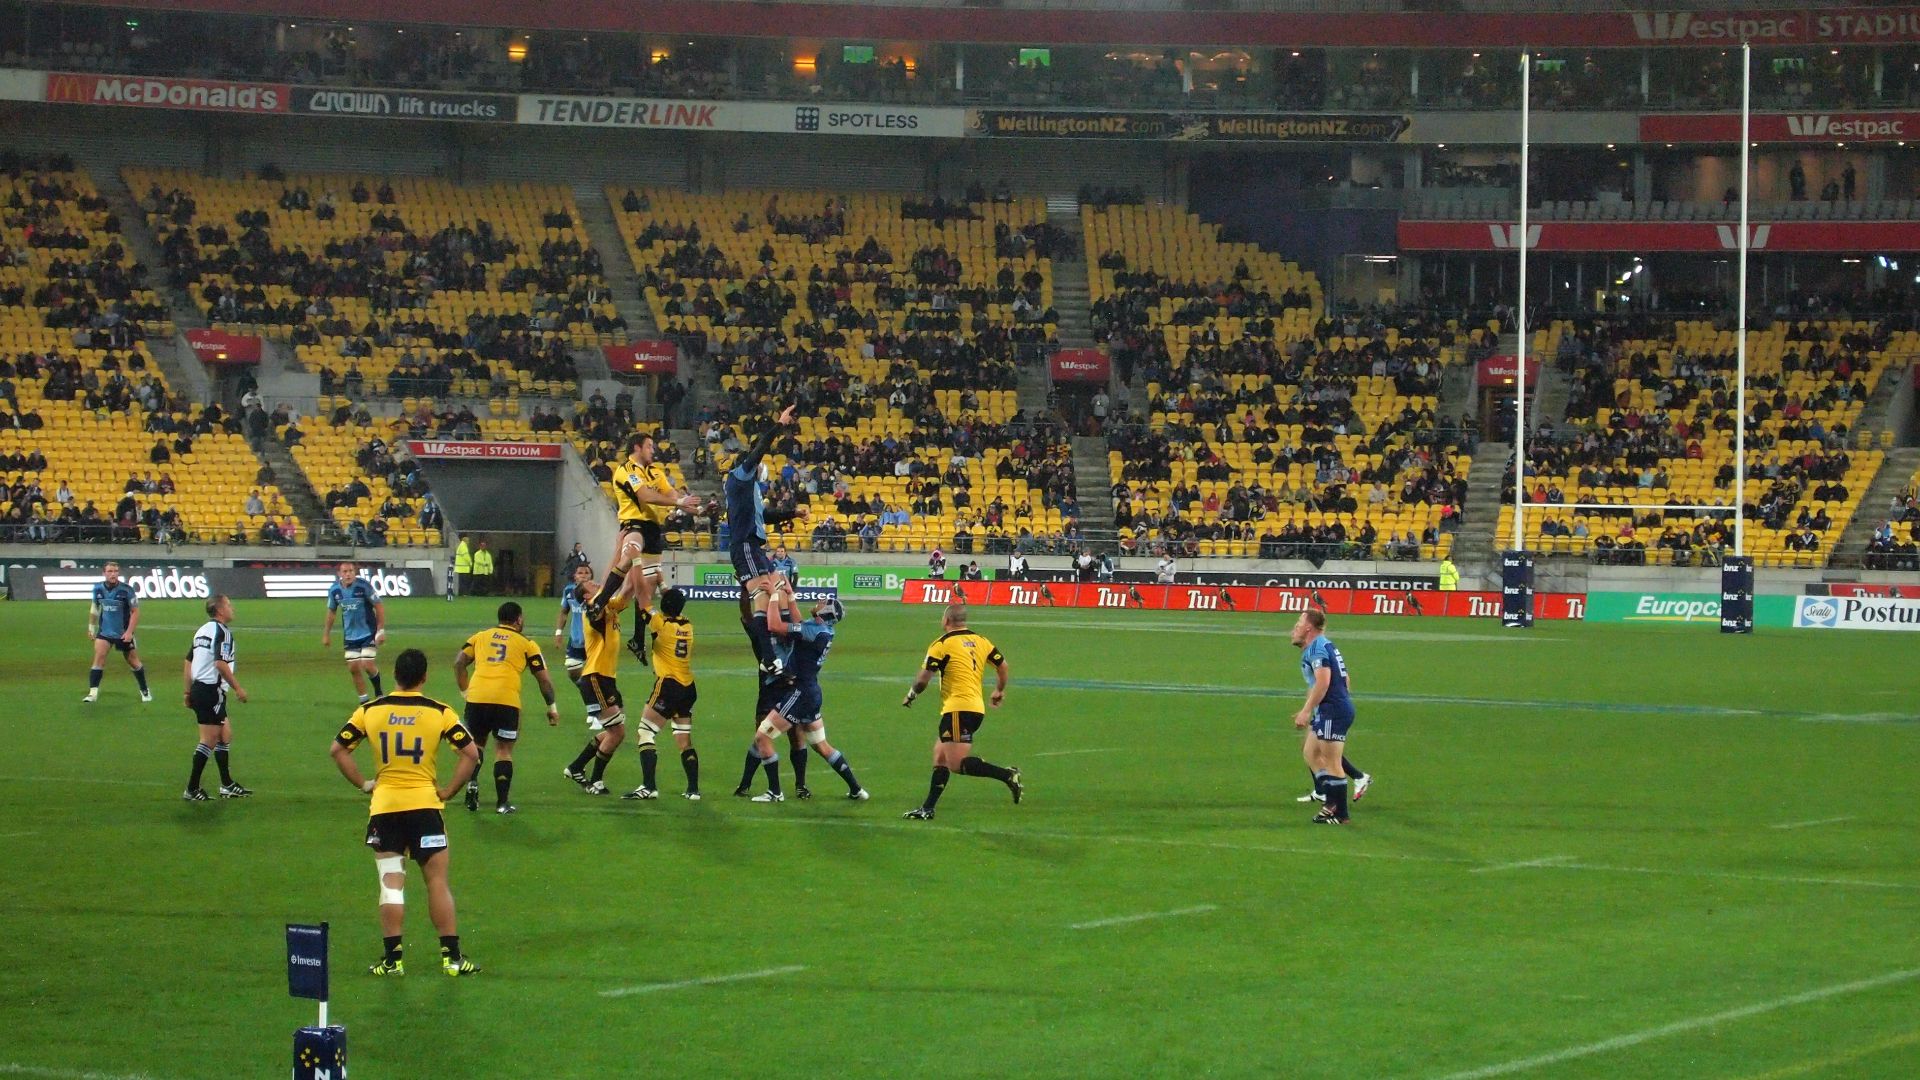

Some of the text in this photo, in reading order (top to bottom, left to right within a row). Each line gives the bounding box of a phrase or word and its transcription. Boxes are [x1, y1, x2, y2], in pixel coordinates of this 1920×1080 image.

[1632, 13, 1796, 40] Westpac
[94, 79, 278, 109] McDonald's
[309, 91, 497, 117] CROWN lift trucks
[538, 100, 718, 127] TENDERLINK
[828, 113, 918, 129] SPOTLESS
[1788, 116, 1904, 139] Westpac
[192, 341, 227, 350] Westpac
[634, 352, 674, 362] Westpac
[1060, 361, 1099, 370] Westpac
[1488, 367, 1528, 376] Westpc
[423, 443, 540, 456] Westpac STADIUM
[1504, 558, 1520, 567] bnz
[1723, 563, 1739, 572] bnz
[128, 568, 210, 598] adidas
[1504, 586, 1520, 595] bnz
[689, 588, 741, 599] Investe
[922, 584, 951, 603] Tui
[1009, 585, 1038, 605] Tui
[1097, 587, 1127, 607] Tui
[1187, 589, 1217, 609] Tui
[1279, 591, 1310, 611] Tui
[1723, 592, 1739, 600] bnz
[1372, 594, 1404, 614] Tui
[1468, 596, 1501, 616] Tui
[1806, 605, 1832, 619] Sealy
[1844, 599, 1920, 623] Postu
[1503, 612, 1519, 620] bnz
[1722, 618, 1738, 626] bnz
[487, 642, 507, 662] 3
[388, 712, 416, 726] bnz
[379, 731, 424, 764] 14
